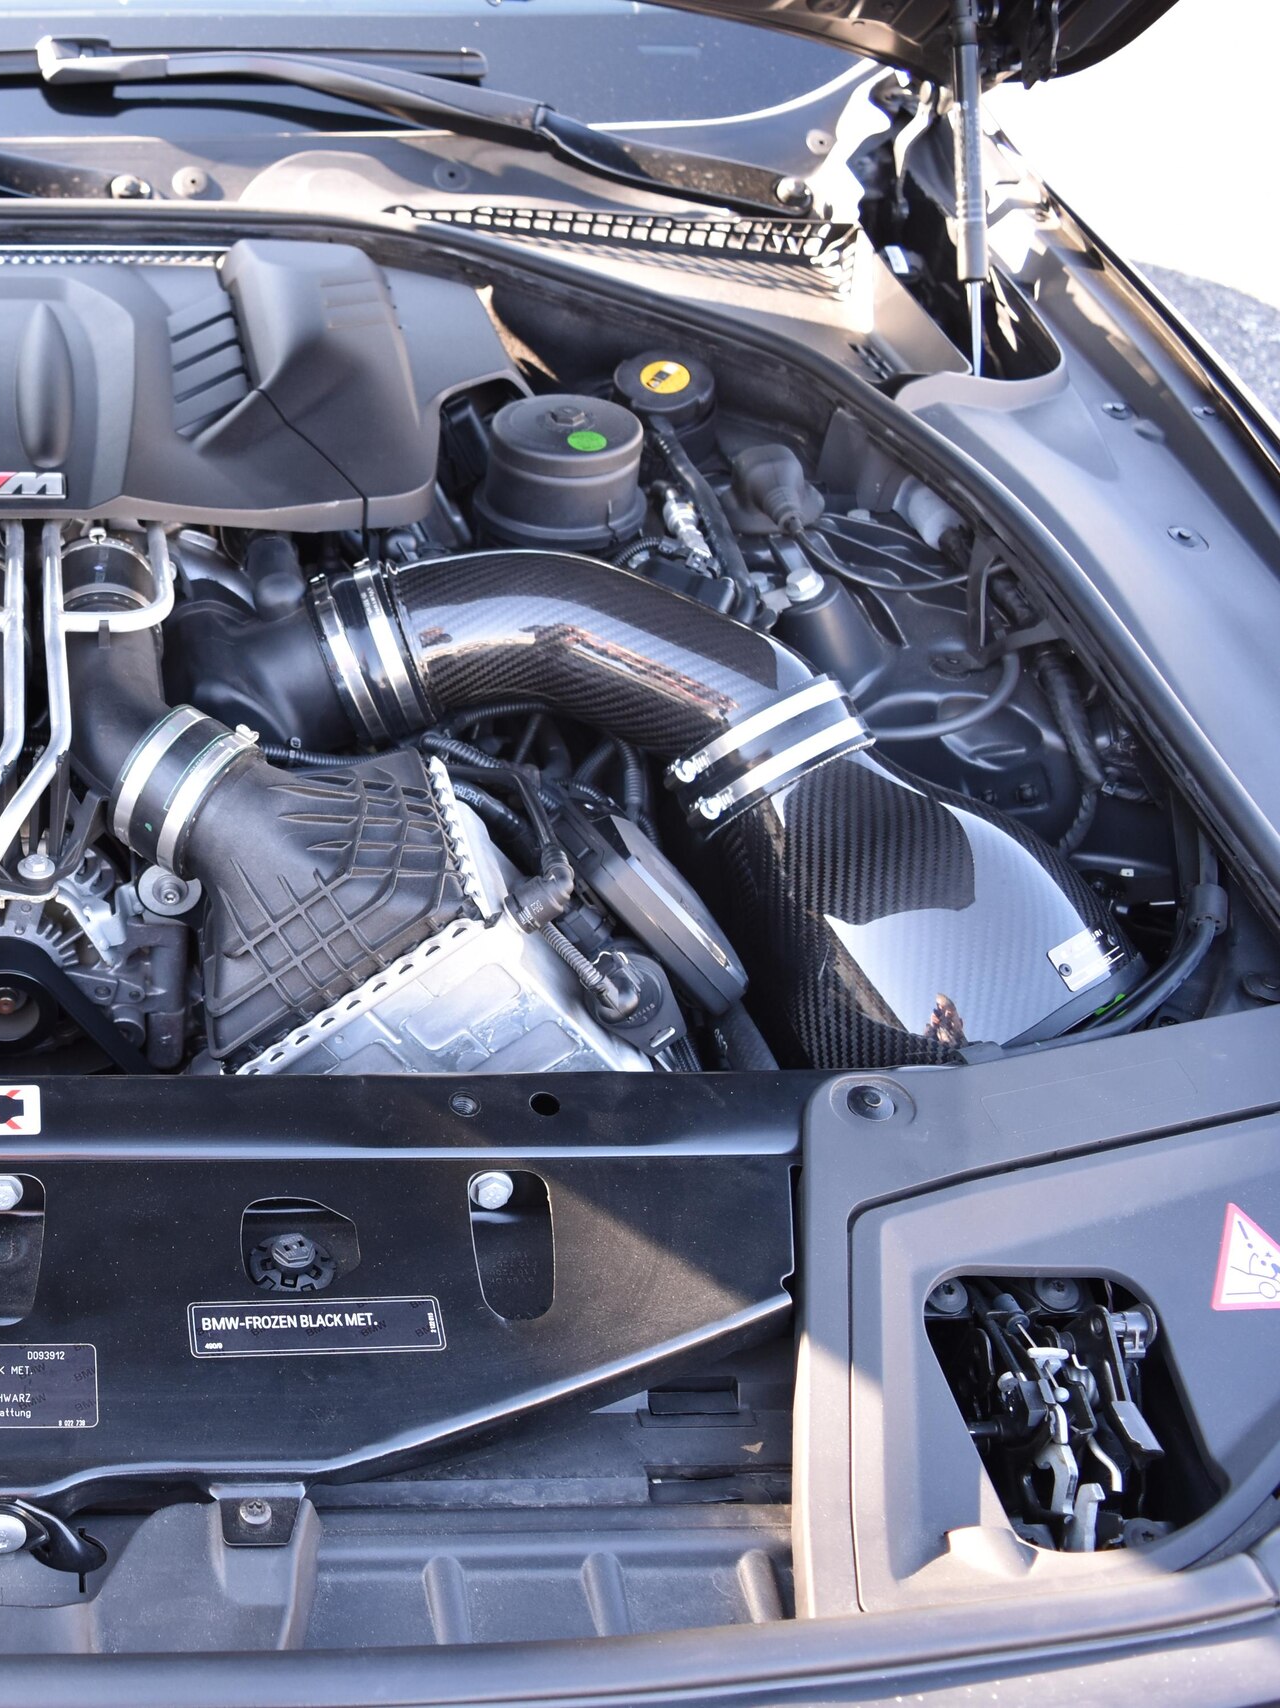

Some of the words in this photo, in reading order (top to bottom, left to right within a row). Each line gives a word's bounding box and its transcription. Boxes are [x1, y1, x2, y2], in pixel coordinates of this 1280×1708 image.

[201, 1314, 298, 1331] BMW-FROZEN
[299, 1313, 344, 1328] BLACK
[344, 1312, 378, 1327] MET.
[10, 1365, 33, 1375] MET.
